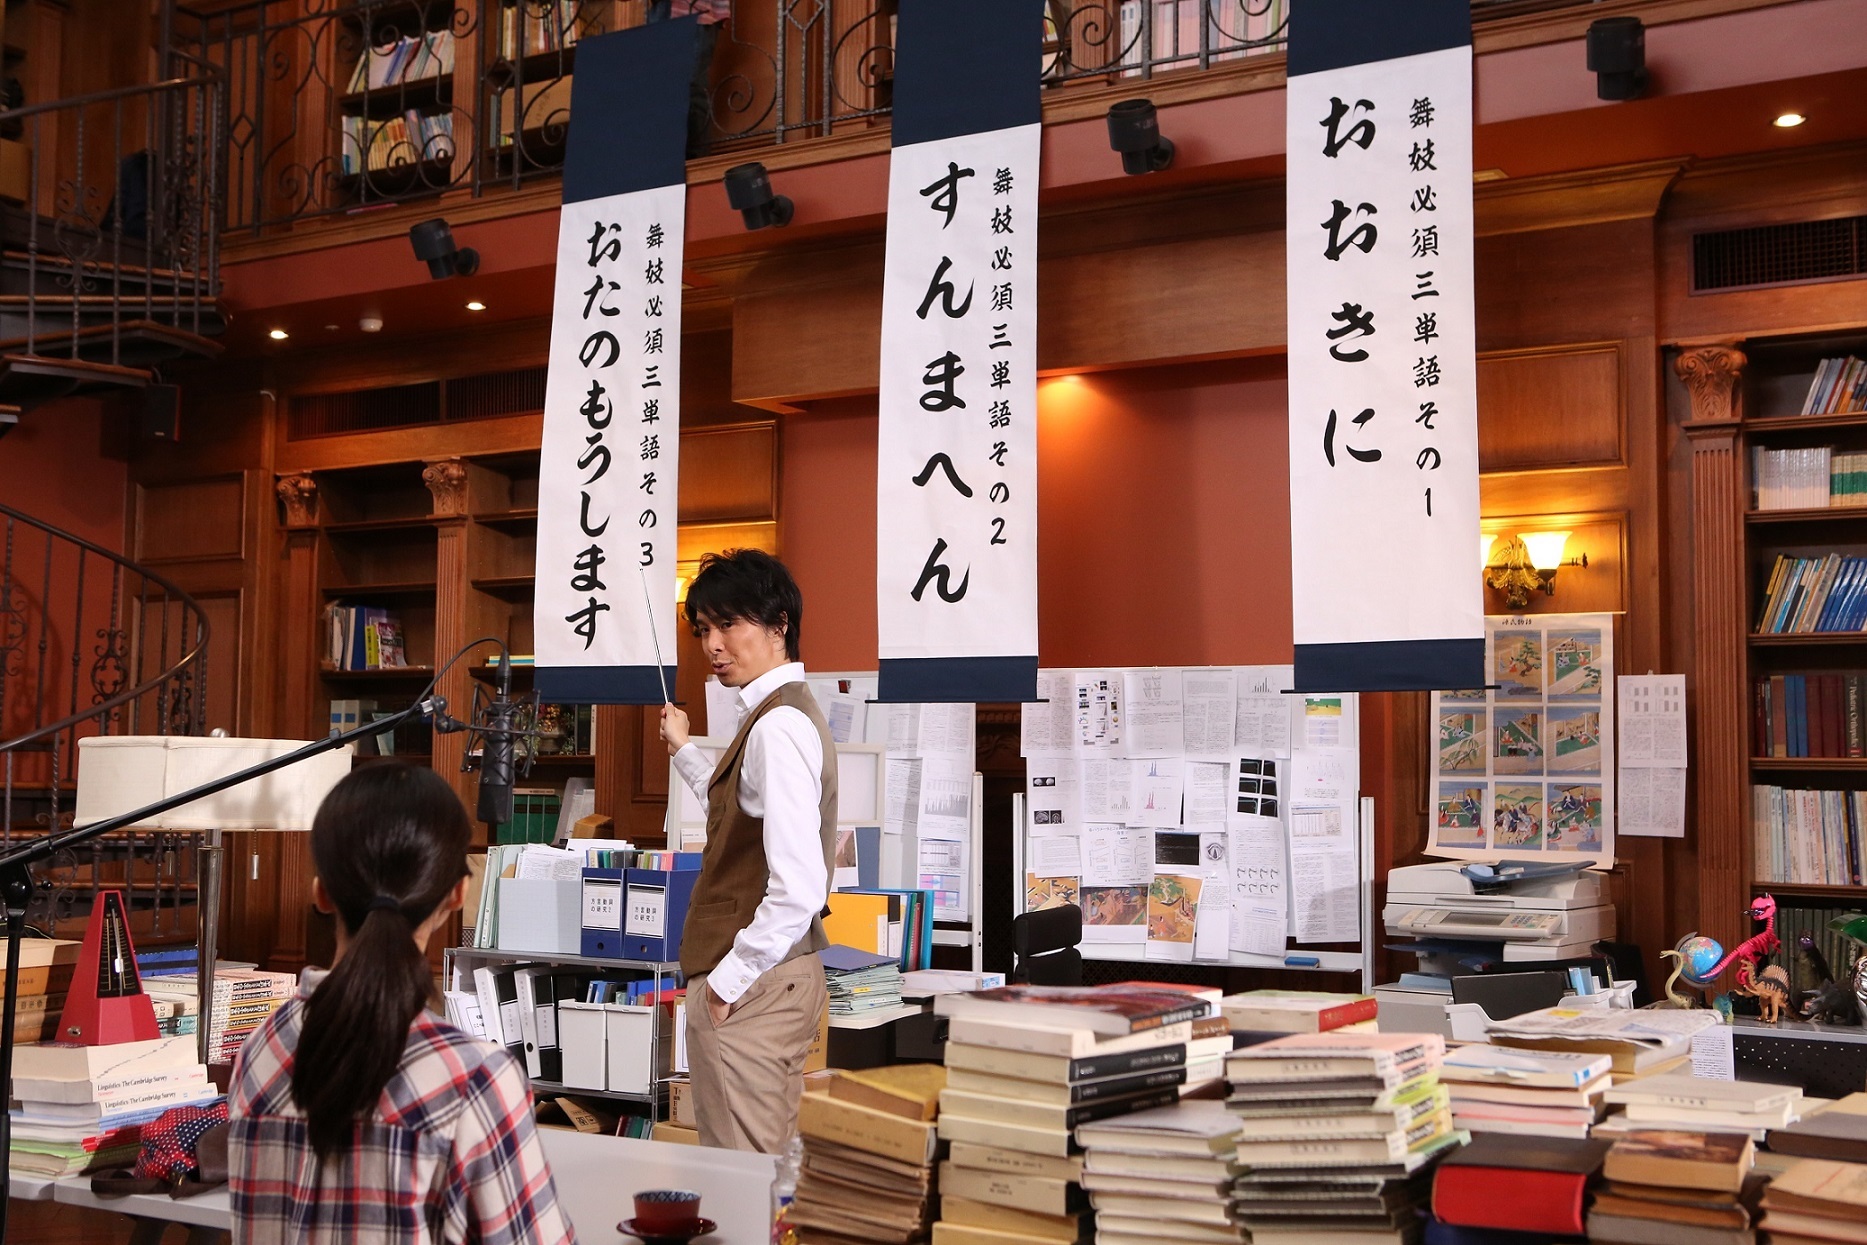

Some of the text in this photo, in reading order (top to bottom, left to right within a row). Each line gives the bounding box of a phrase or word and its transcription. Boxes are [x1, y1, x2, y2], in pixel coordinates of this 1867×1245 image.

[565, 220, 621, 651] おたのもうします
[638, 222, 665, 566] 舞妓必須三単語その3
[910, 161, 976, 604] すんまへん
[988, 167, 1014, 546] 舞妓必須三単語その2
[1319, 96, 1382, 468] おおきに
[1408, 96, 1442, 517] 舞妓必須三単語その1
[122, 1080, 131, 1088] The
[131, 1077, 153, 1086] Cambridge
[153, 1075, 168, 1083] Survey
[139, 1093, 161, 1102] Cambridge
[161, 1091, 176, 1099] Survey
